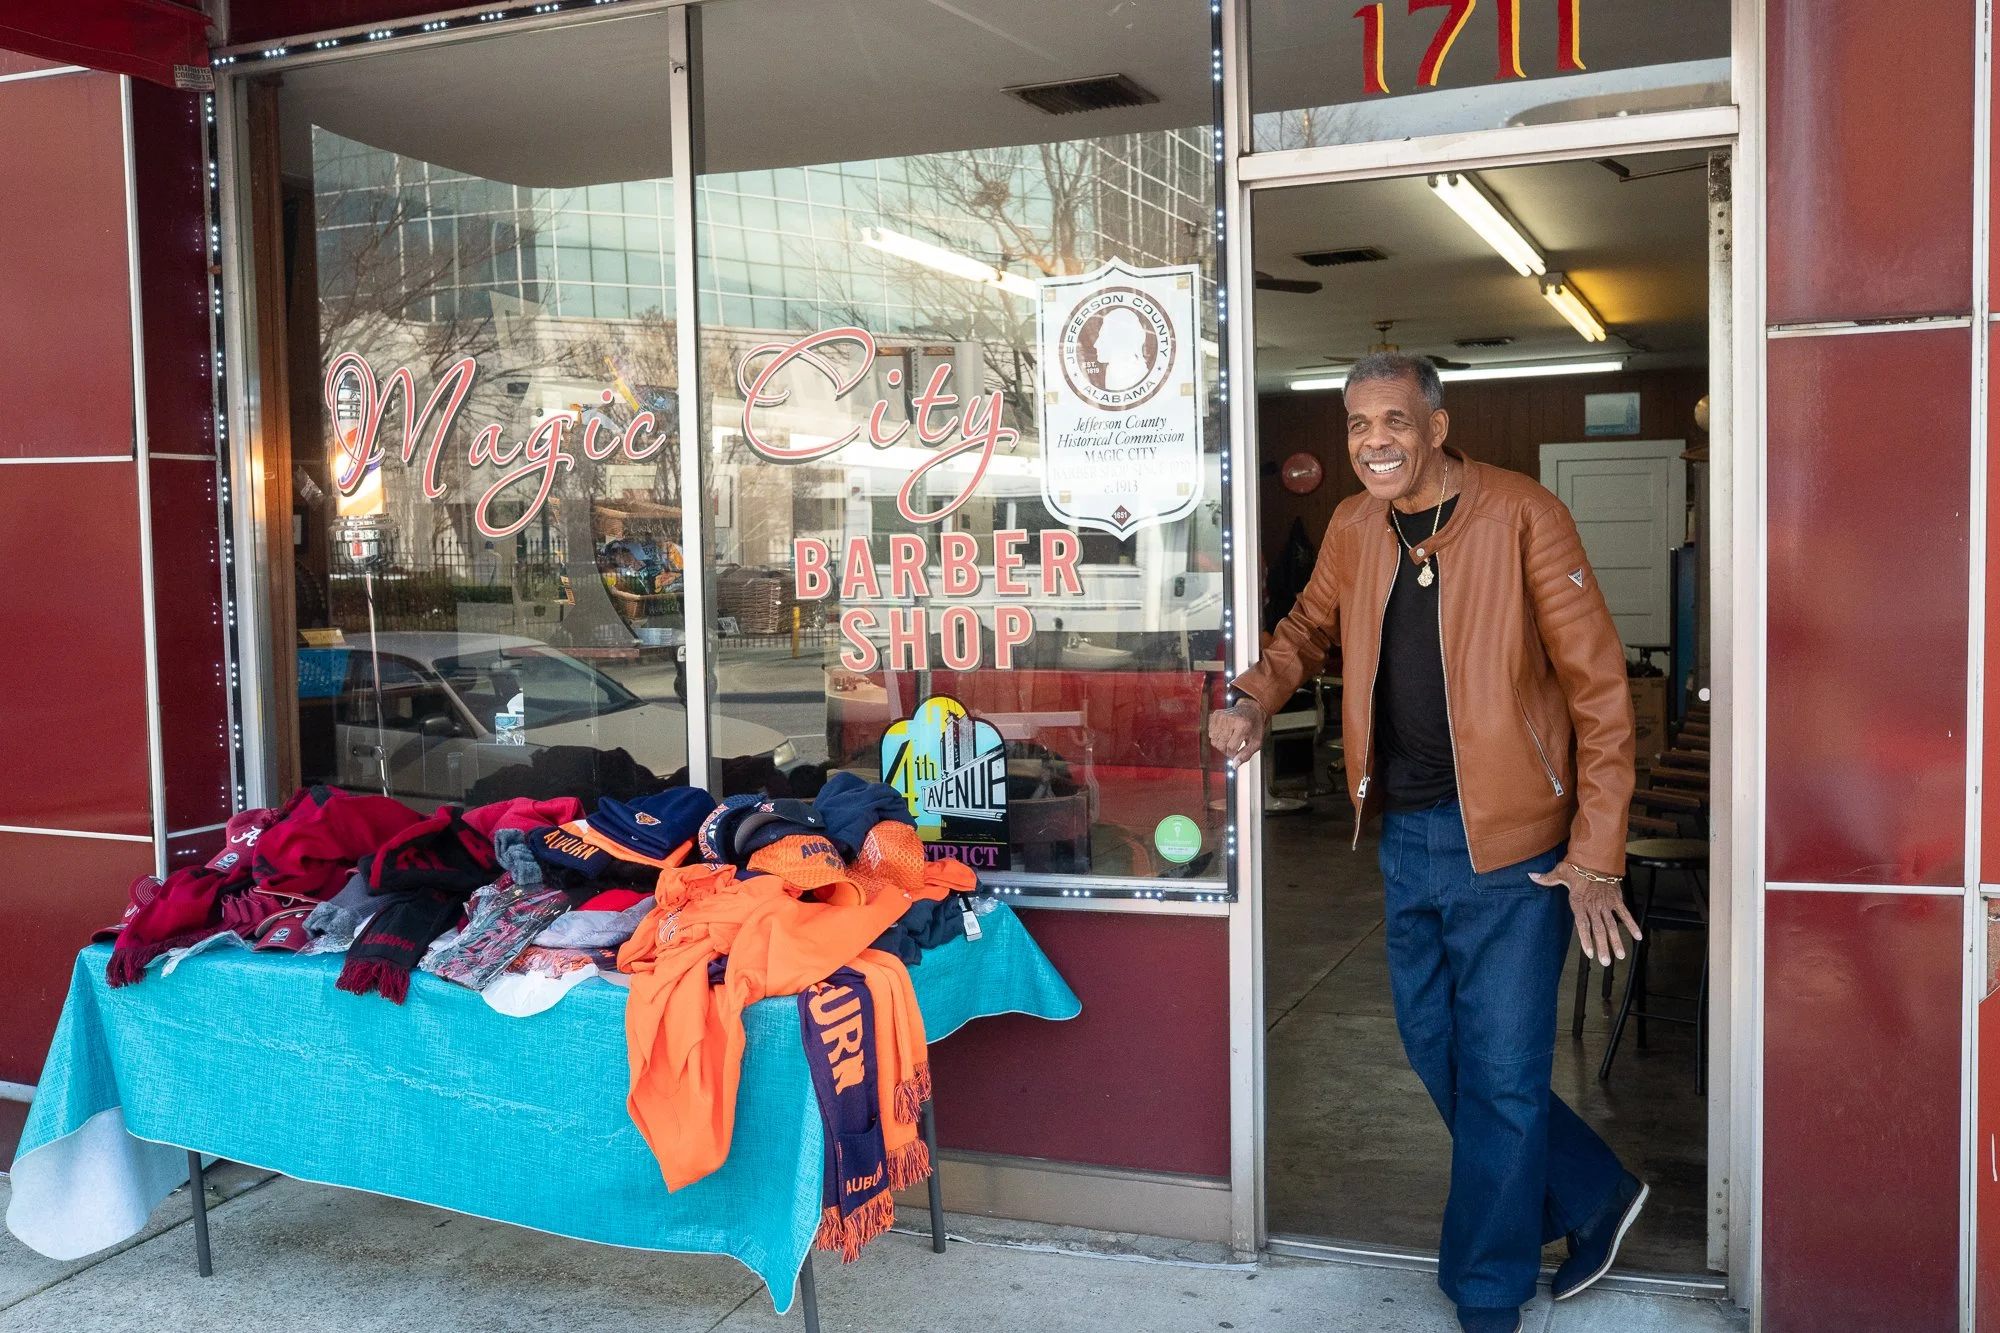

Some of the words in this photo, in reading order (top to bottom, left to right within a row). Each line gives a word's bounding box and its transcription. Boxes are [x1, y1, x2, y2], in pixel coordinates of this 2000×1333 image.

[1352, 0, 1587, 94] 1711
[1065, 294, 1124, 364] JEFFERSON
[1132, 297, 1169, 358] COUNTY
[1084, 381, 1156, 403] ALABAMA
[325, 352, 666, 537] Magic
[737, 326, 1019, 523] City
[1057, 431, 1113, 448] Historical
[1115, 428, 1185, 445] Commission
[1074, 417, 1121, 434] Jefferson
[1126, 415, 1167, 430] County
[1085, 449, 1124, 463] MAGIC
[1127, 447, 1157, 461] CITY
[1113, 511, 1128, 519] 1651
[794, 528, 1084, 600] BARBER
[840, 605, 1034, 672] SHOP
[885, 739, 937, 818] 4th
[927, 753, 1008, 810] AVENUE
[924, 845, 998, 867] STRICT
[808, 984, 865, 1096] URN
